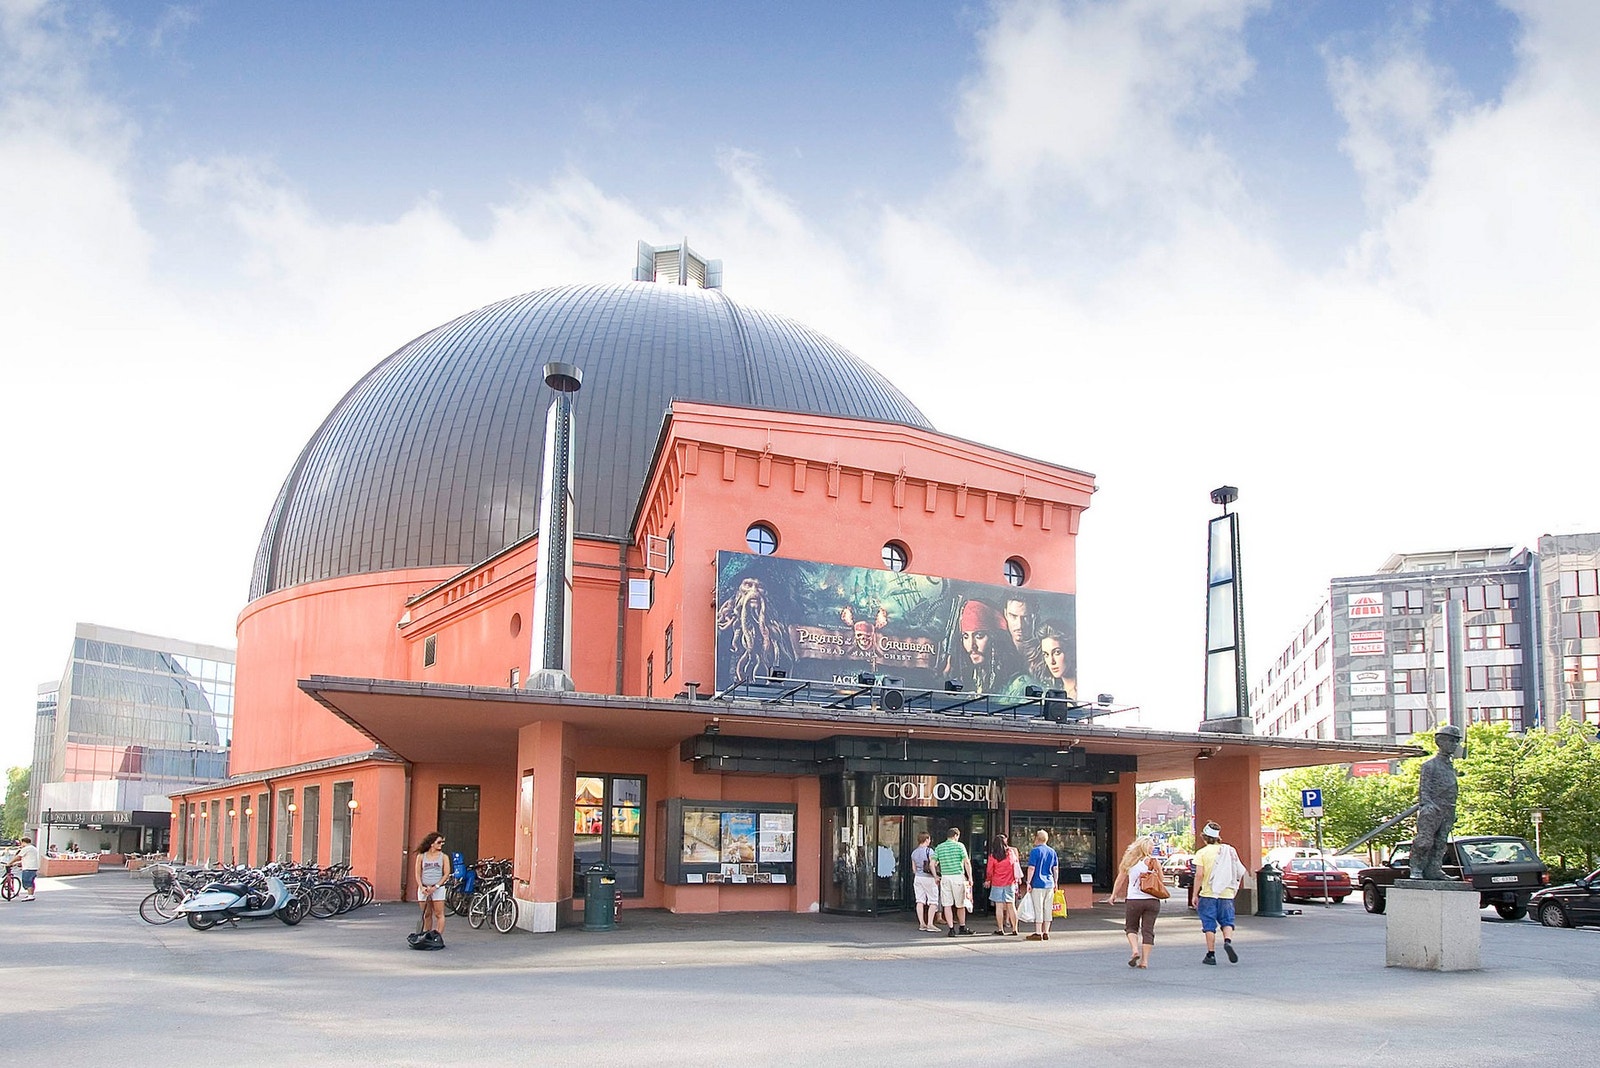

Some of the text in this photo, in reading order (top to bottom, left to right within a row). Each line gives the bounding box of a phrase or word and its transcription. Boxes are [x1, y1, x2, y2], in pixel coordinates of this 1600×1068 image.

[796, 628, 844, 646] PIRATES
[879, 636, 935, 654] CARIBBEAN
[819, 647, 845, 655] DEAD
[883, 653, 912, 661] CHEST
[883, 781, 1006, 803] COLOSSEUM
[1306, 791, 1317, 806] P
